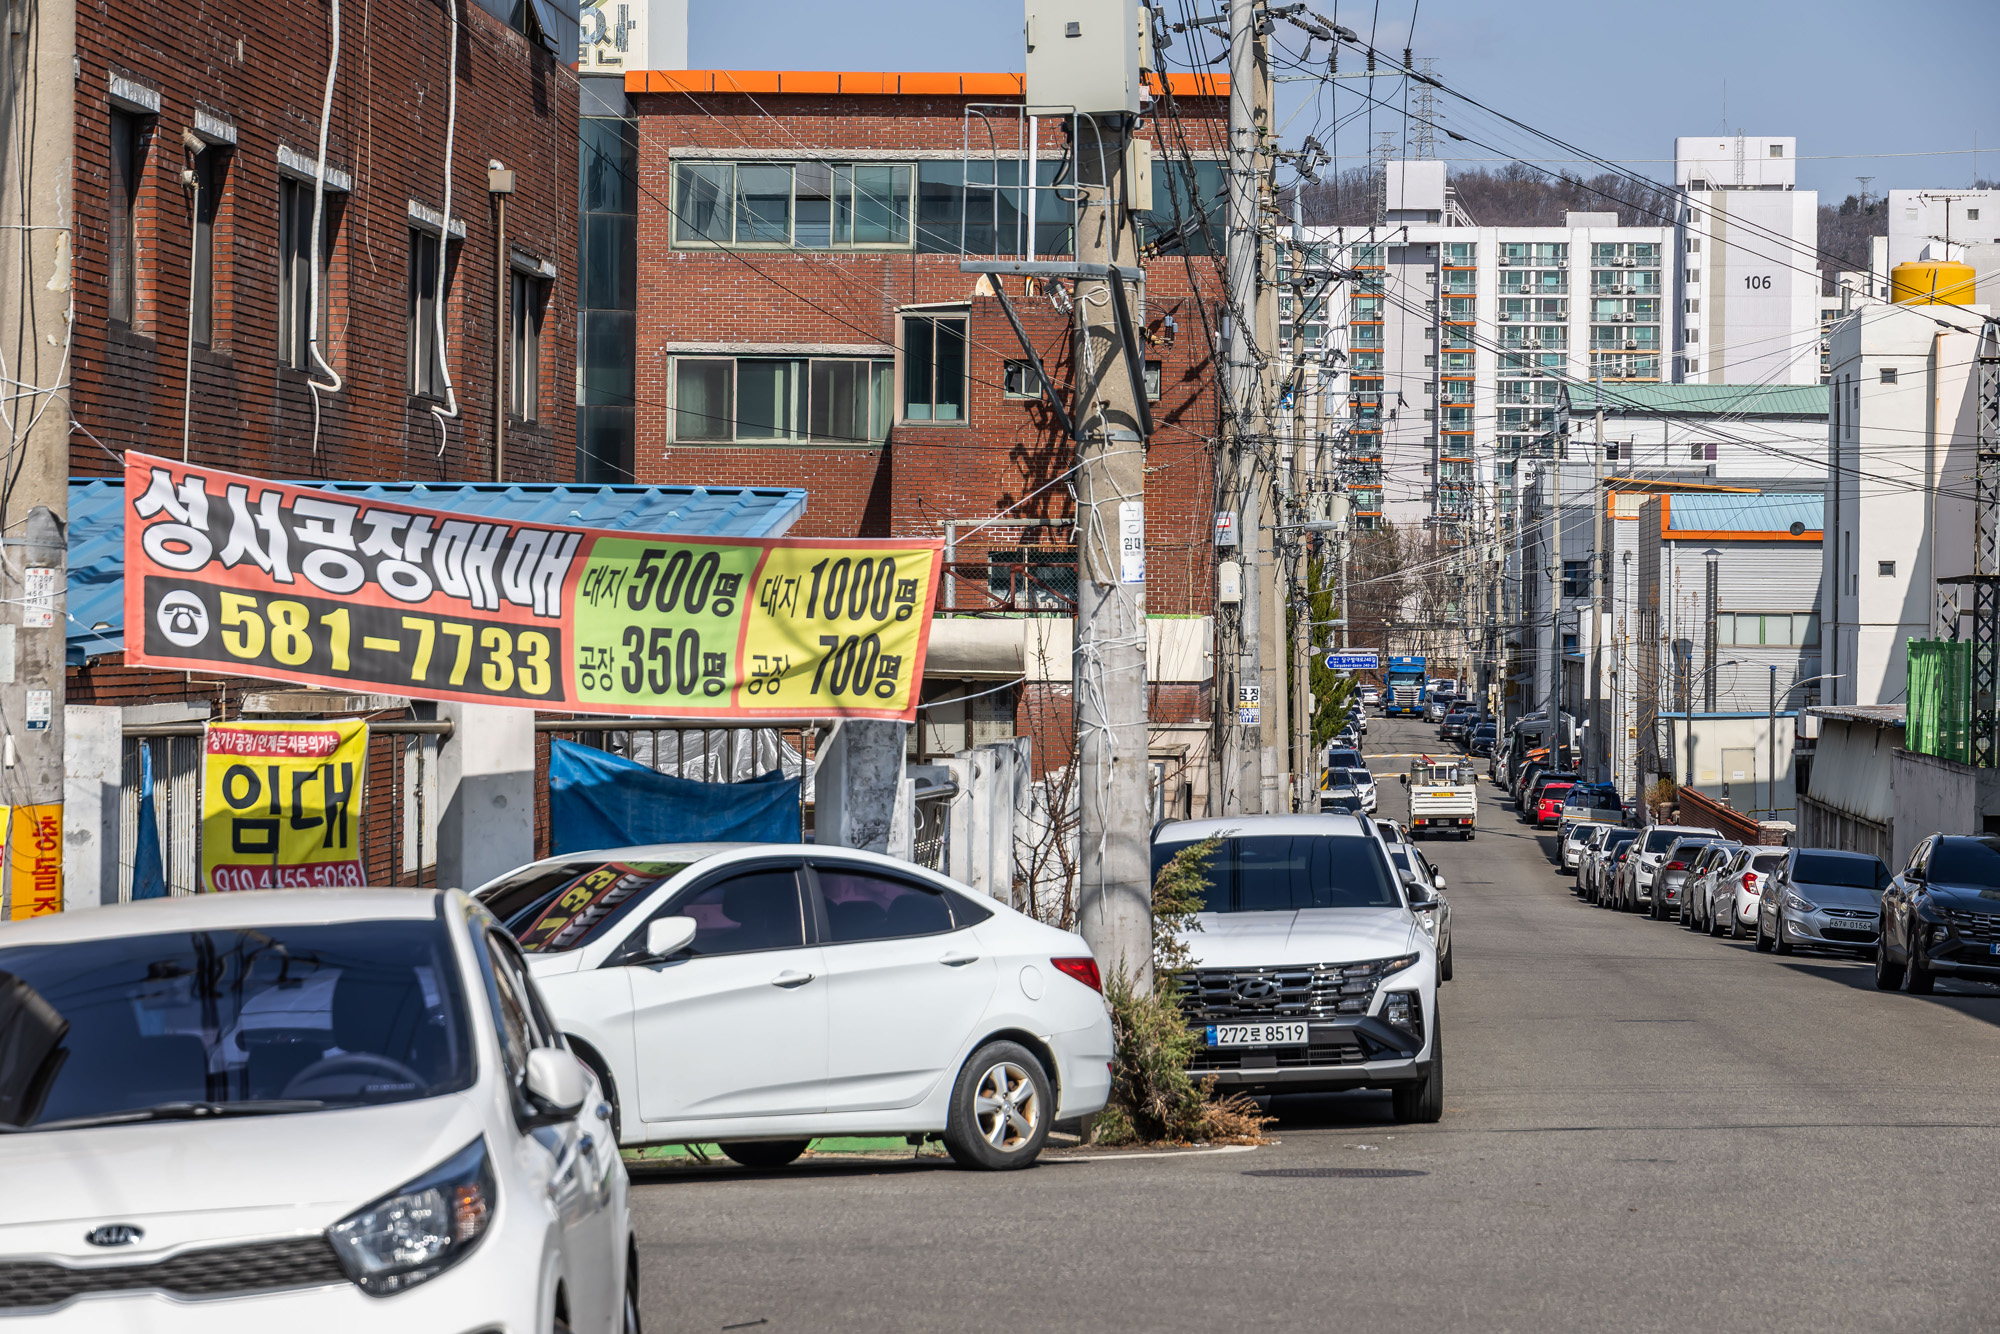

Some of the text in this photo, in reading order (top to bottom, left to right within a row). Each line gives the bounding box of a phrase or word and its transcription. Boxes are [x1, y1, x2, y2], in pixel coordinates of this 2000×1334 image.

[1745, 276, 1771, 289] 106
[134, 467, 585, 619] 성서공장매매
[583, 549, 744, 617] 대지 500평
[760, 557, 918, 621] 대지 1000평
[220, 591, 552, 695] 581-7733
[579, 626, 726, 697] 공장 350평
[748, 633, 902, 699] 공장 700평
[222, 762, 353, 854] 임대
[1220, 1025, 1304, 1043] 272로 8519
[93, 1227, 134, 1243] KIA
